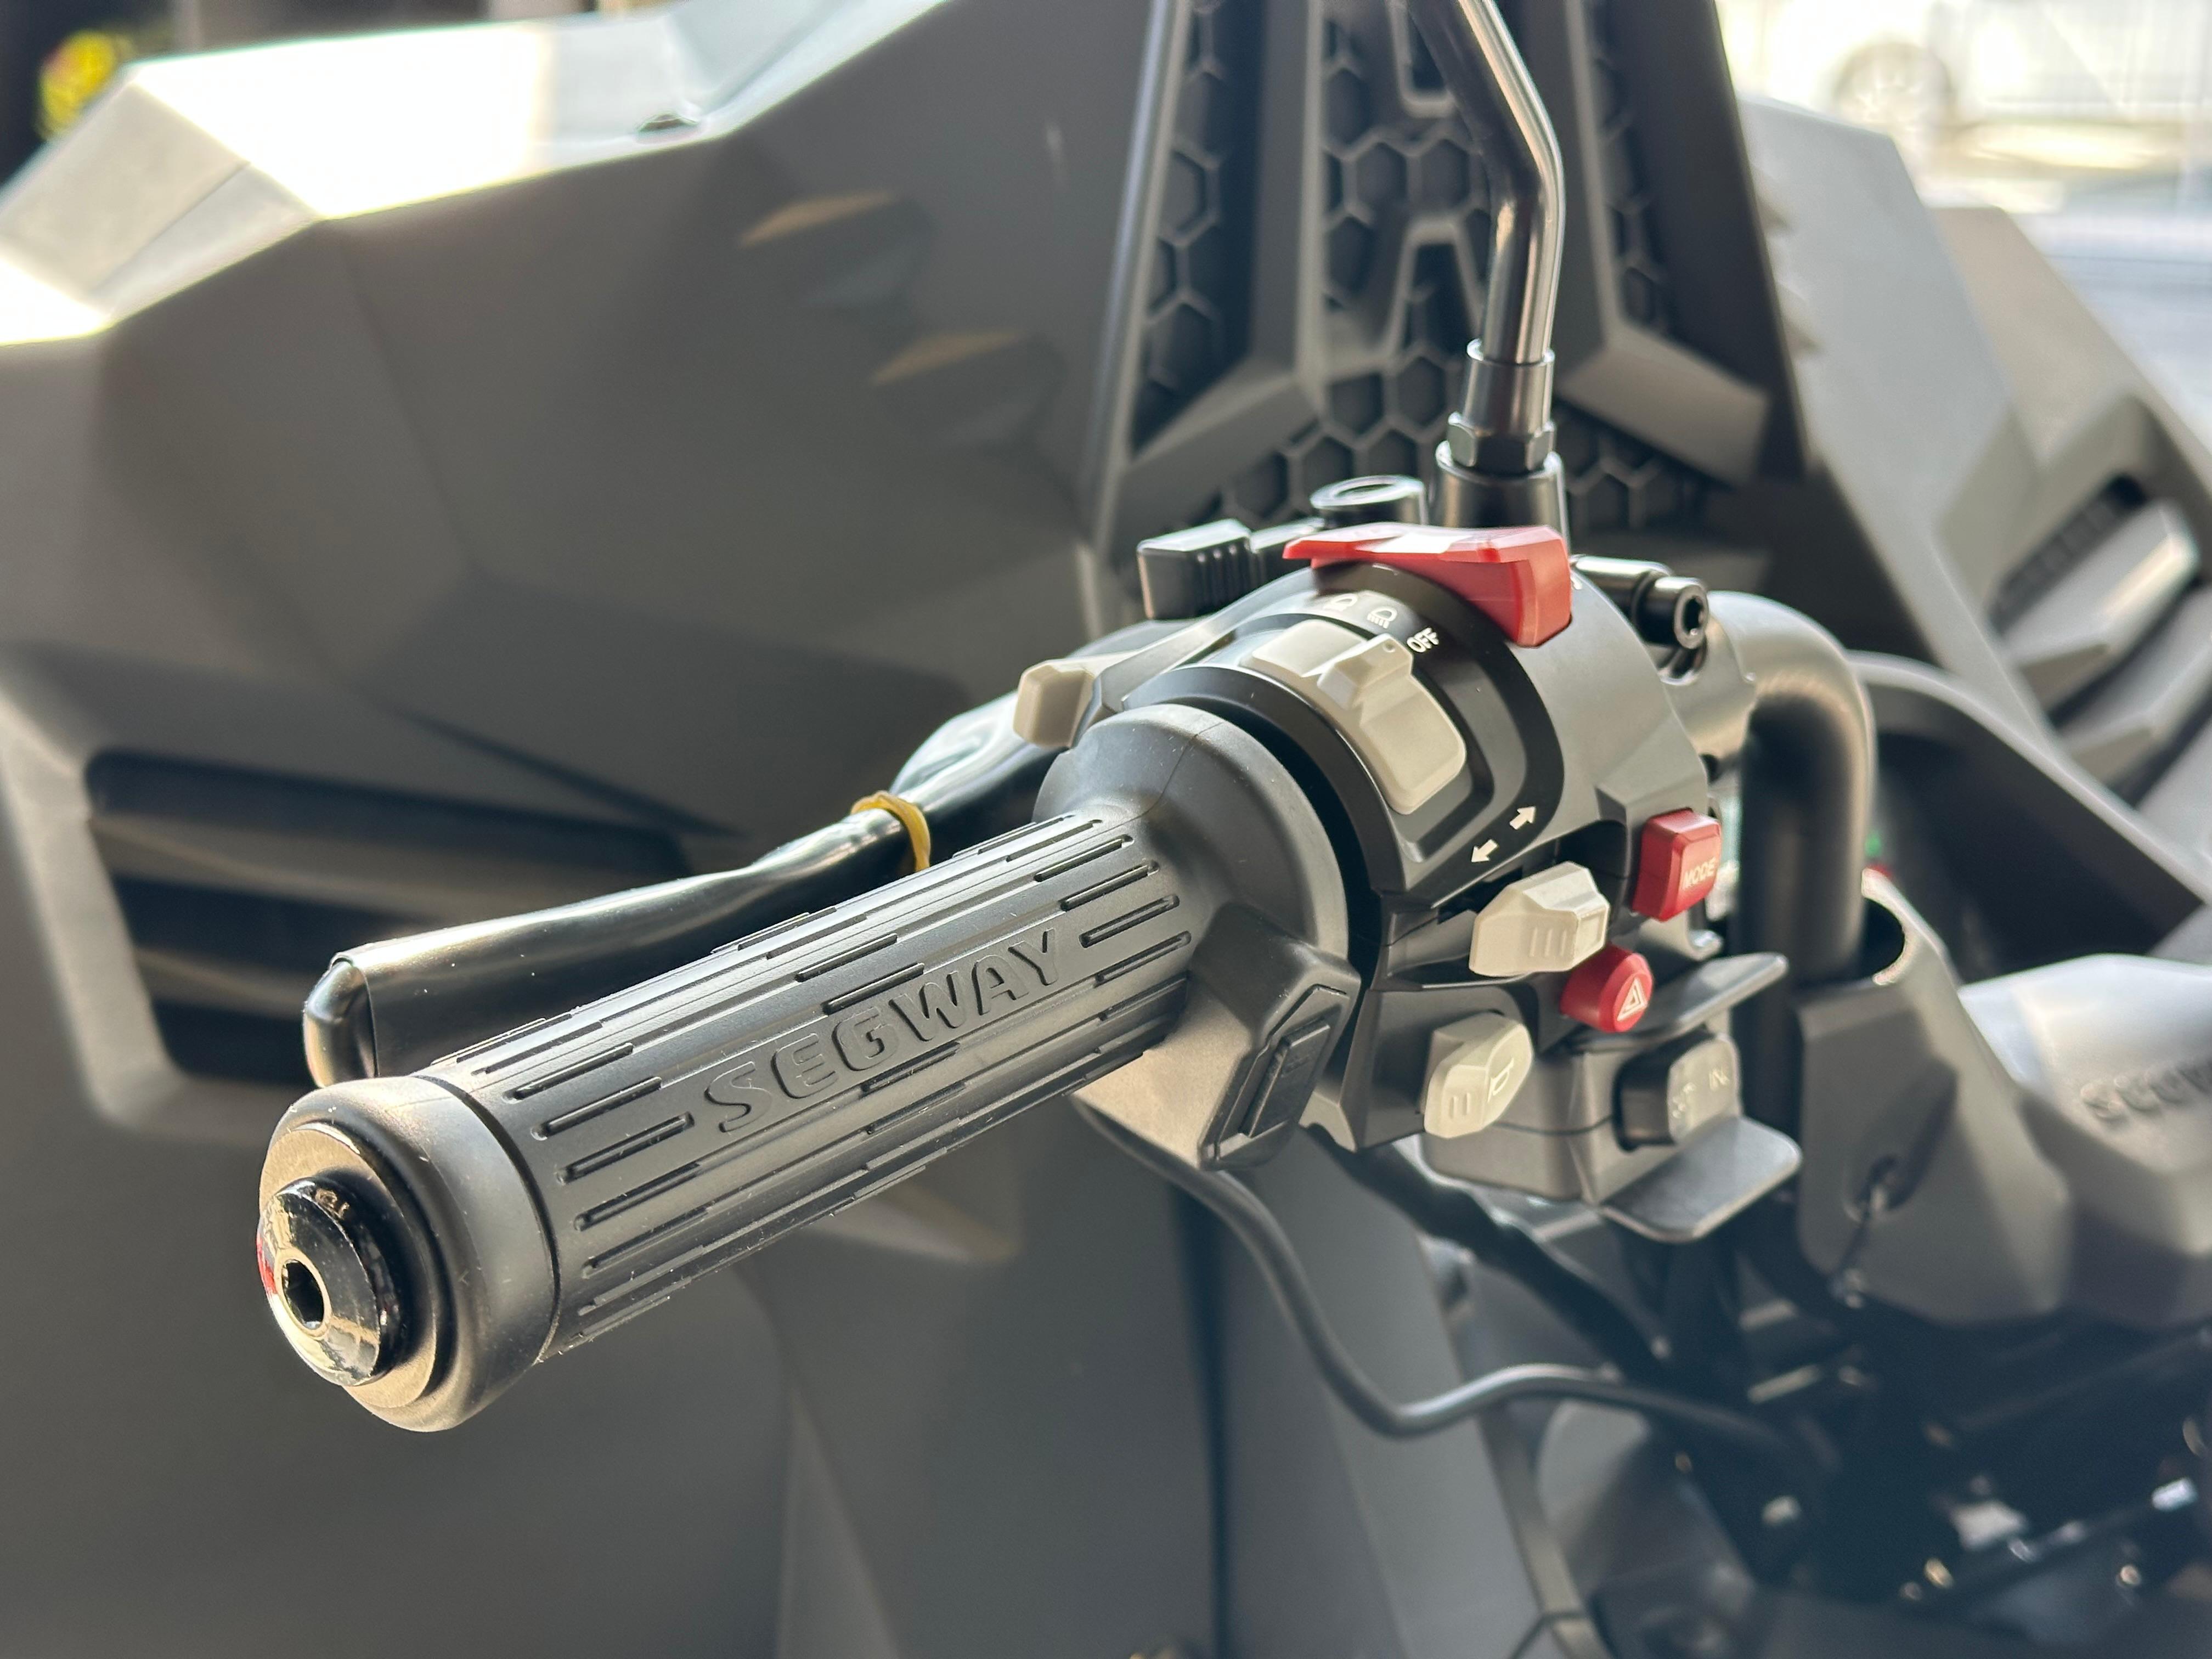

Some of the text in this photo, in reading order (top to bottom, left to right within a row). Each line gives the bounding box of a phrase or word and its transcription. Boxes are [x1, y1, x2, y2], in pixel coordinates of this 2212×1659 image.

[1407, 628, 1439, 653] OFF
[1681, 856, 1716, 890] MODE
[704, 927, 1057, 1133] SEGWAY
